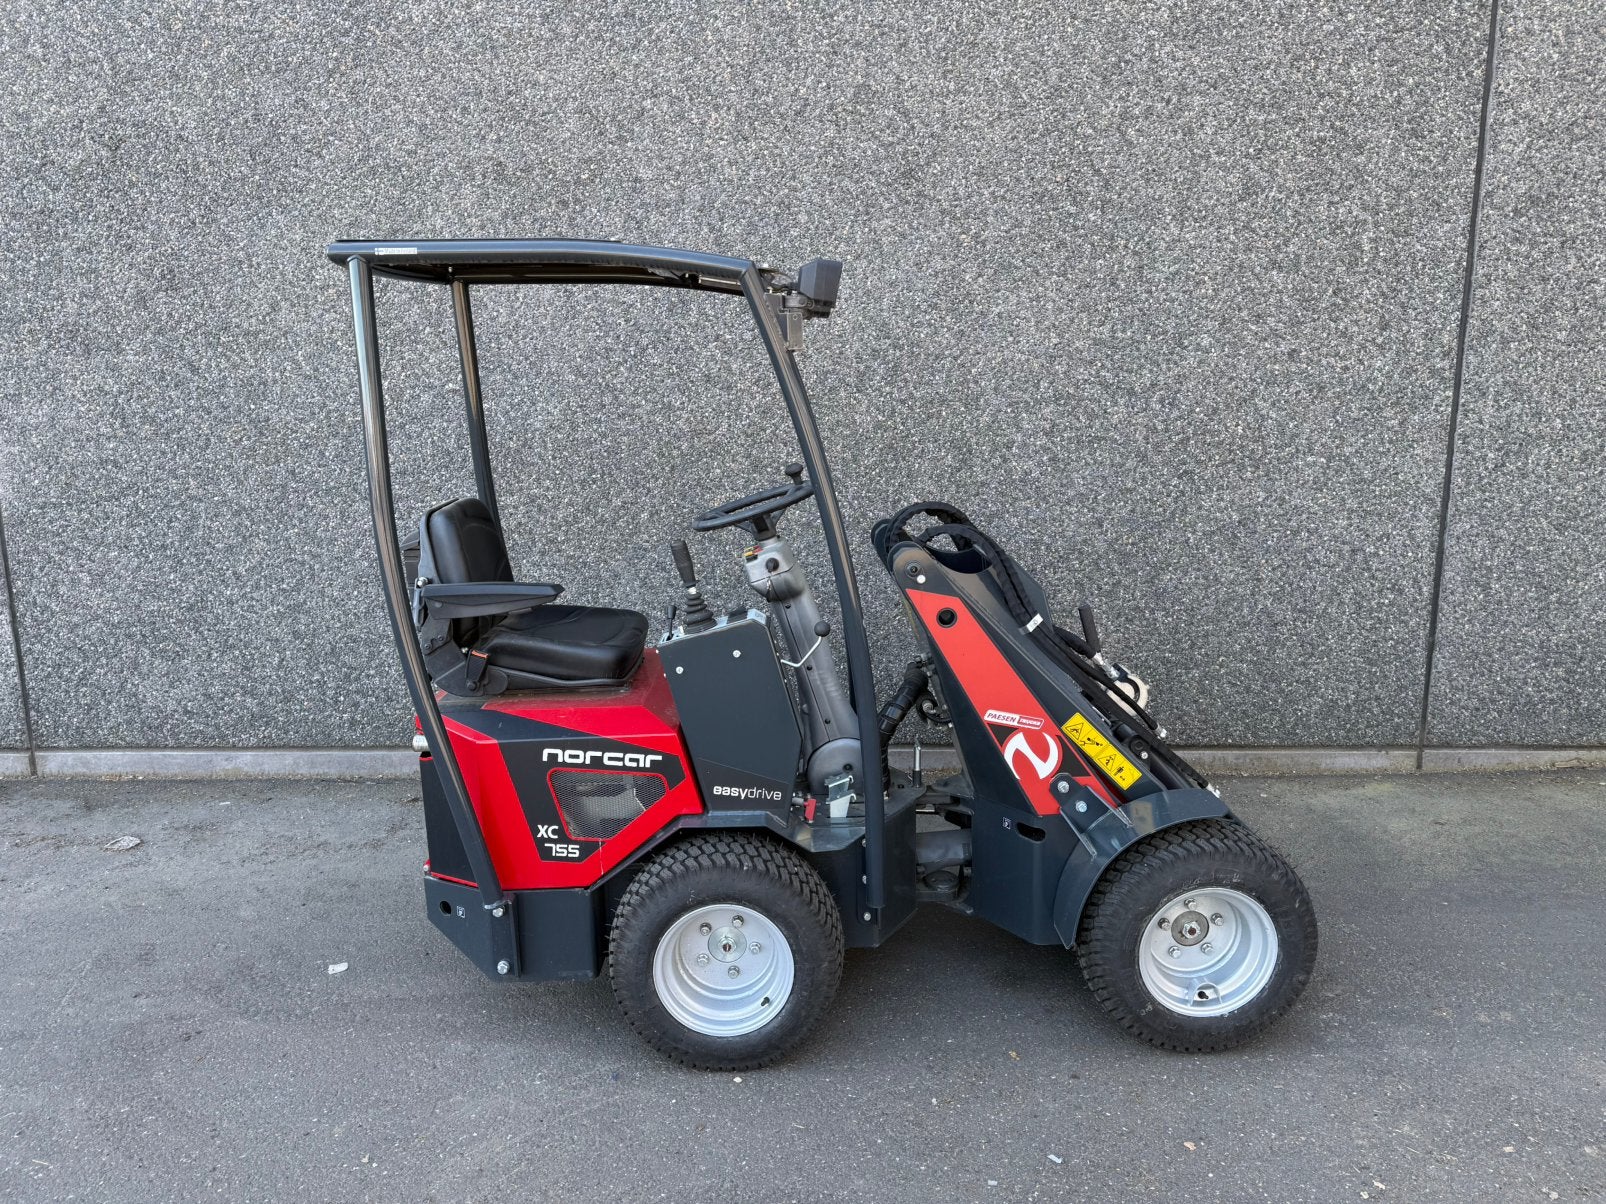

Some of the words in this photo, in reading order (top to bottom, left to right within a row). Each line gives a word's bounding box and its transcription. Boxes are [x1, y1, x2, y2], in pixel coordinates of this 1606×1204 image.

[987, 713, 1016, 723] PAESEN
[542, 748, 662, 767] norcar
[713, 785, 782, 800] easydrive
[537, 824, 559, 839] XC
[544, 843, 580, 857] 755
